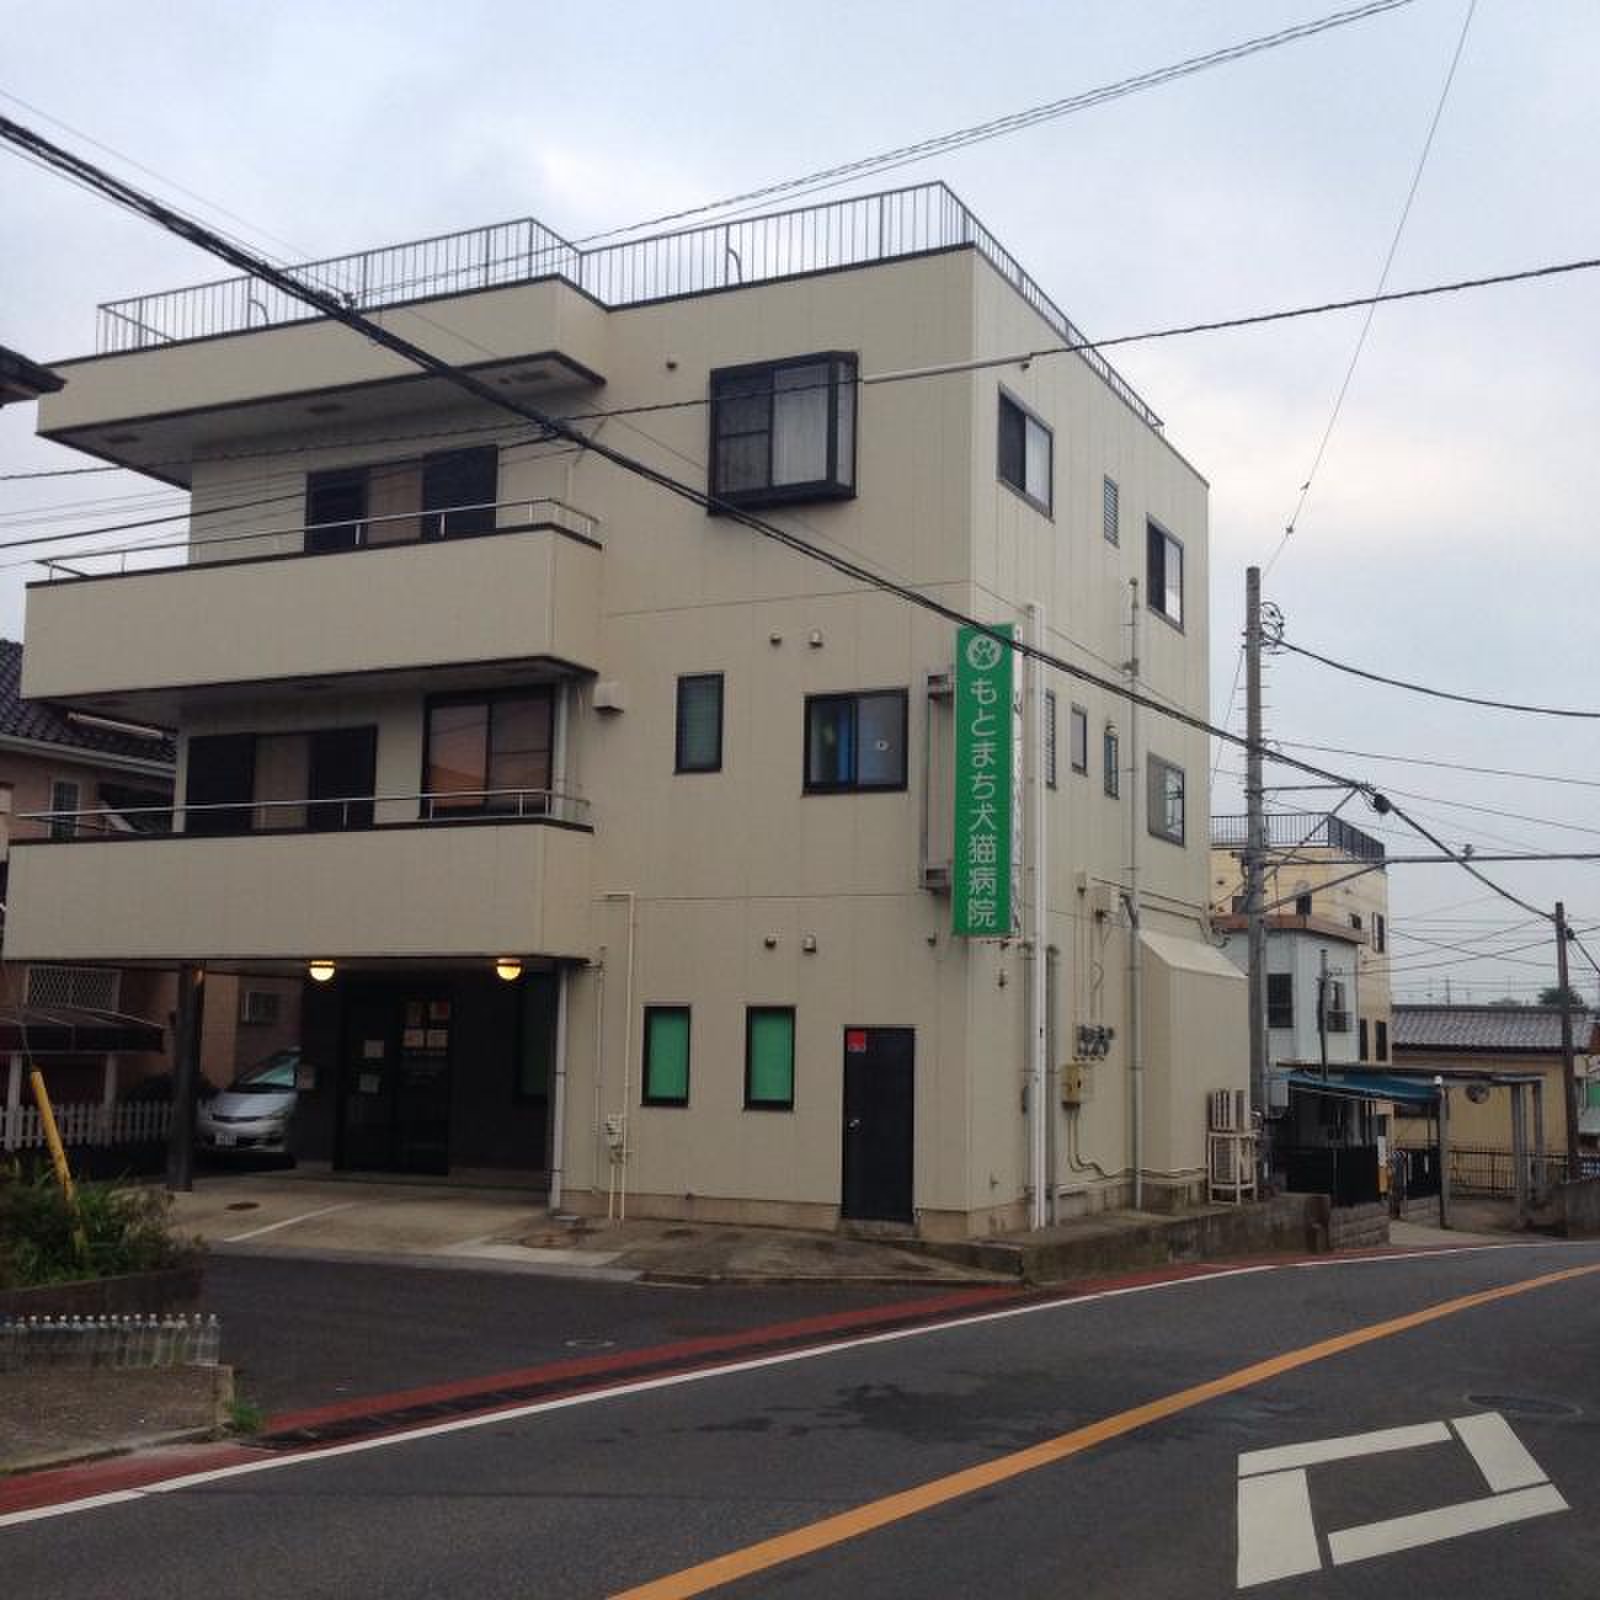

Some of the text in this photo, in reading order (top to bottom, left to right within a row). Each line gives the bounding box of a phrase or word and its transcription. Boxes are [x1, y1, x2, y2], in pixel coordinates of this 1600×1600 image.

[968, 680, 996, 928] もとまち犬猫病院
